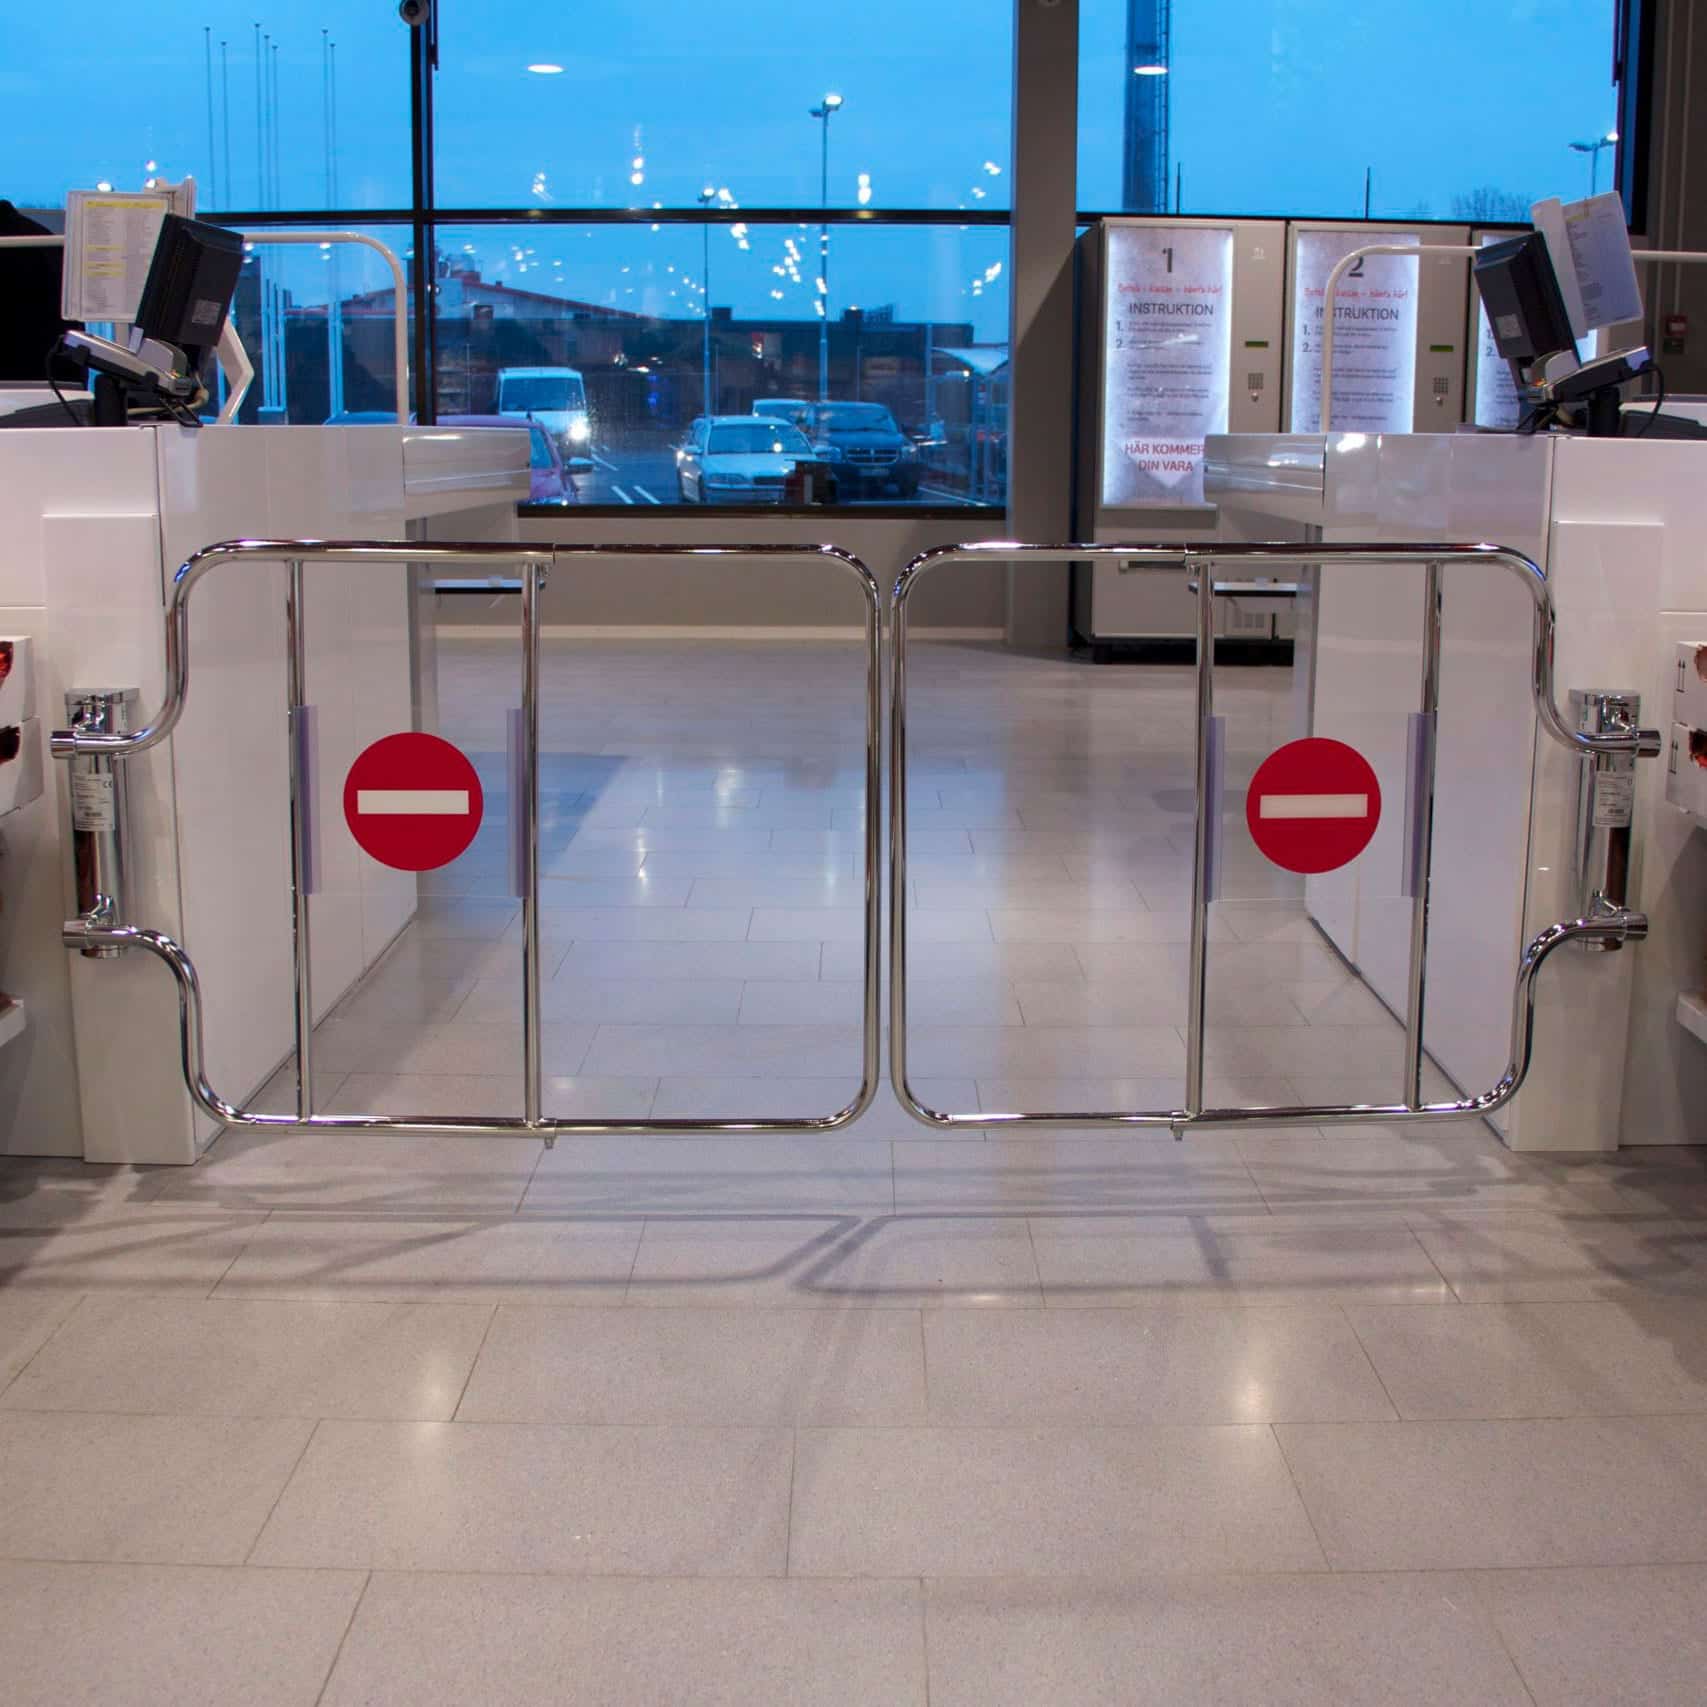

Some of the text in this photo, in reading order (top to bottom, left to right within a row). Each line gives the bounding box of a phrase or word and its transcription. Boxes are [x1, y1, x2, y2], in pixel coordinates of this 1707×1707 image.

[1162, 247, 1173, 273] 1
[1348, 256, 1364, 278] 2
[1129, 303, 1214, 315] INSTRUKTION
[1303, 324, 1311, 336] 1.
[1302, 342, 1312, 353] 2.
[1125, 440, 1150, 455] HÄR
[1138, 460, 1194, 473] DIN VARA
